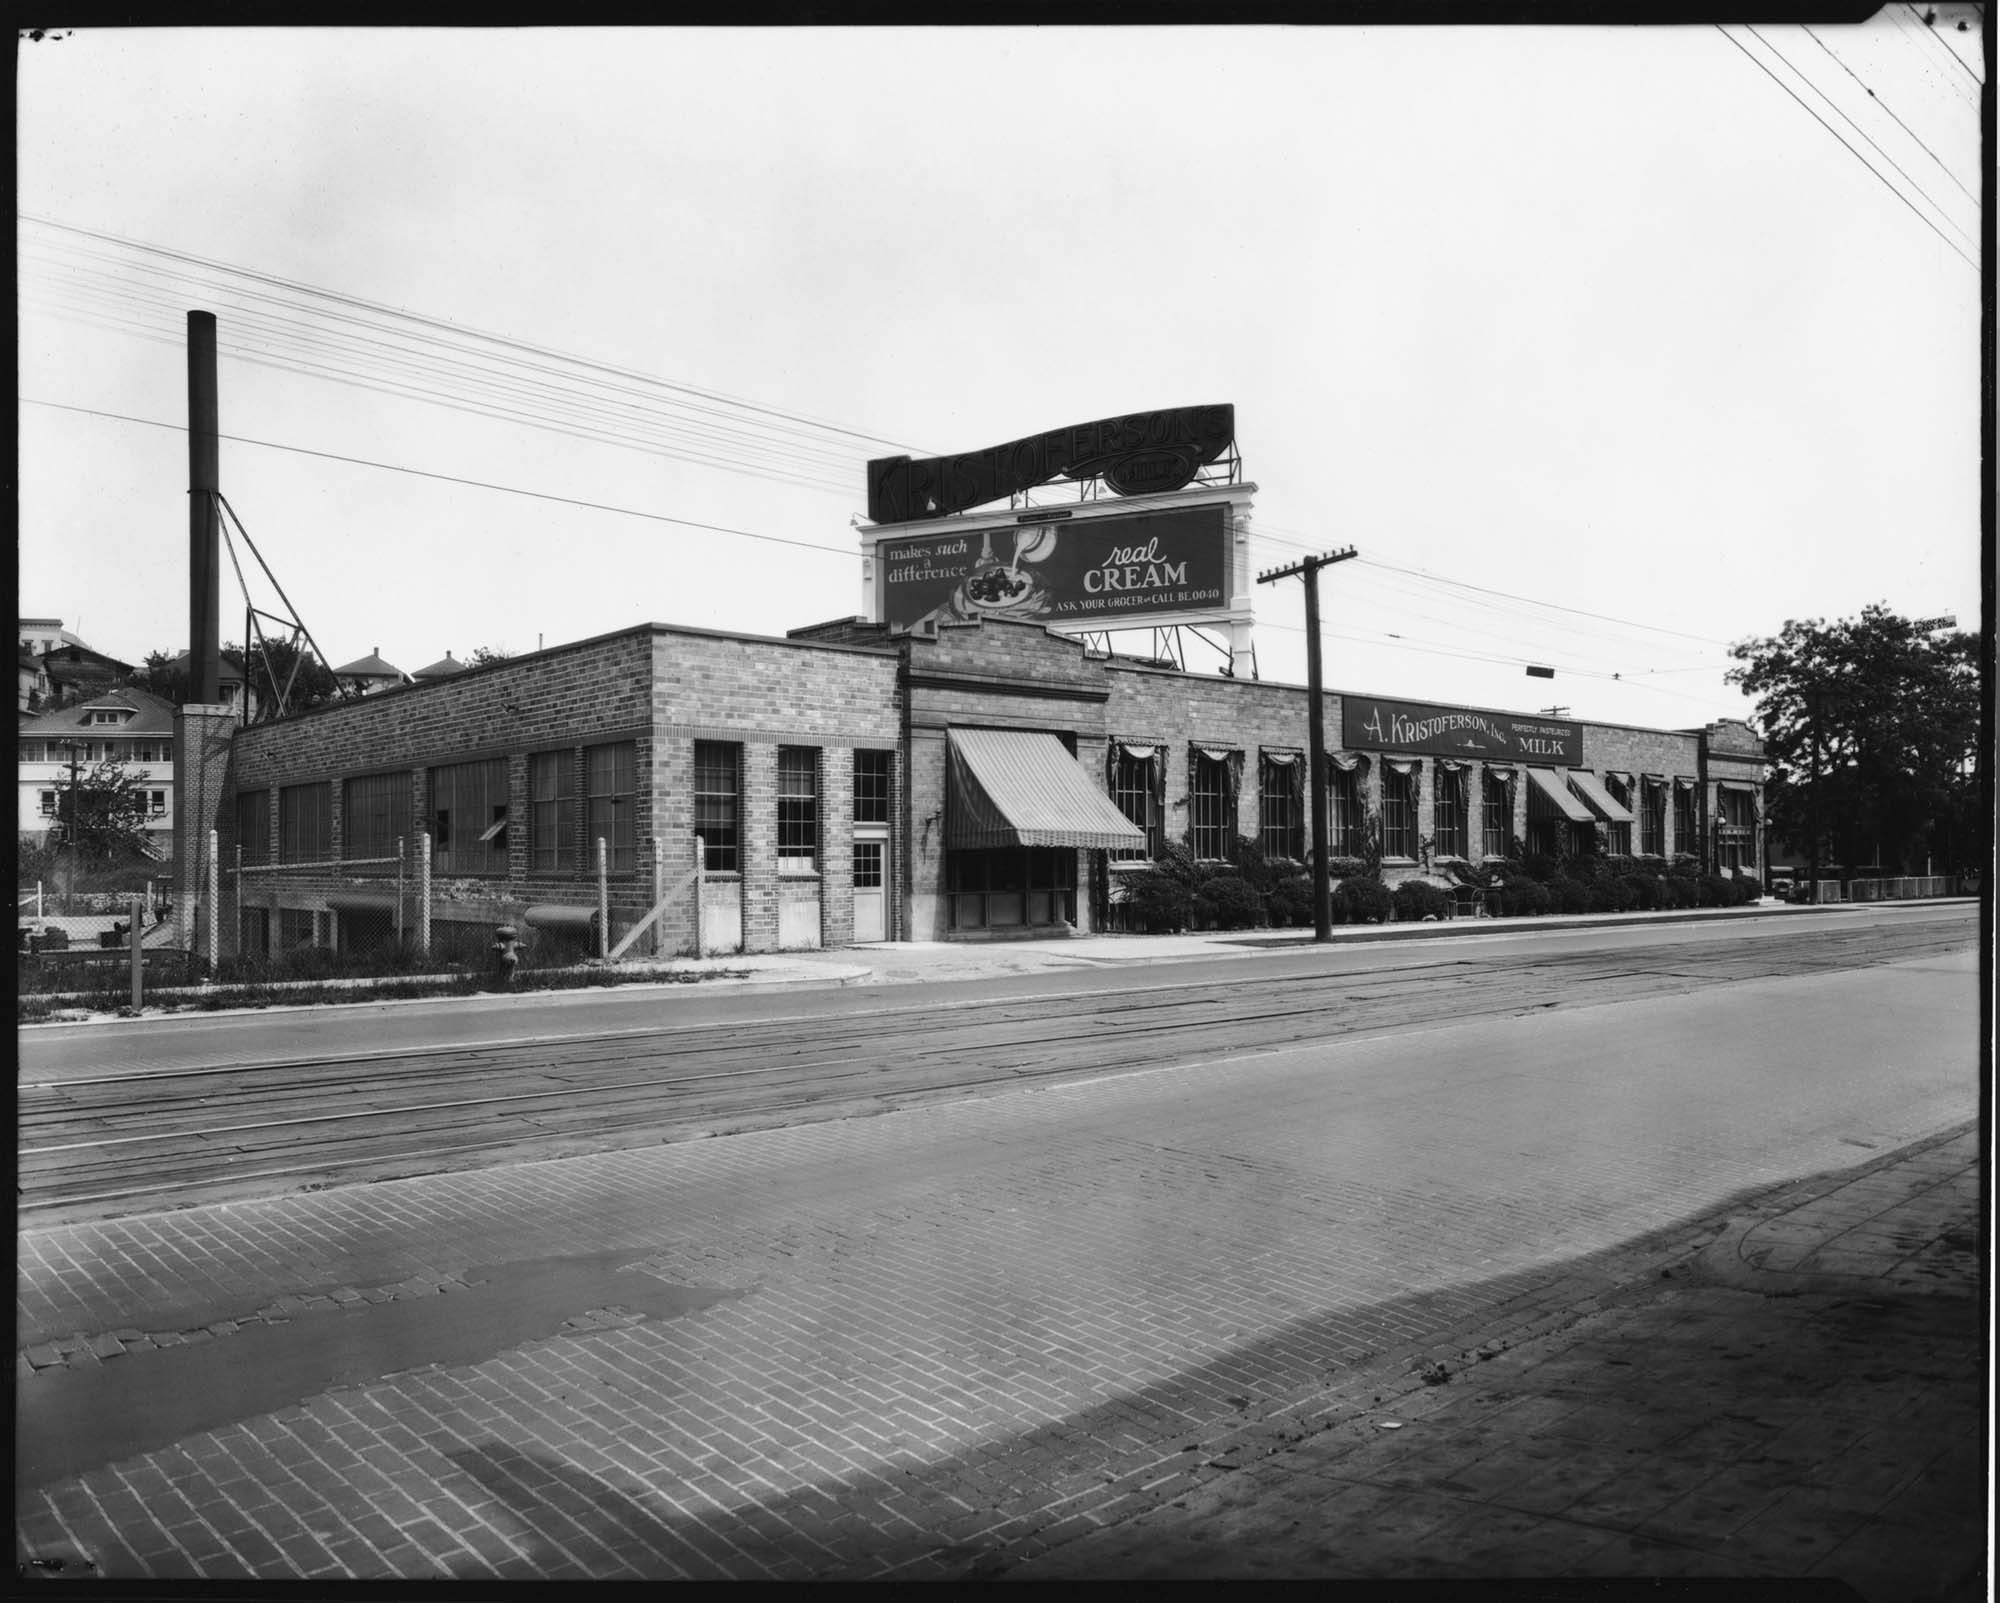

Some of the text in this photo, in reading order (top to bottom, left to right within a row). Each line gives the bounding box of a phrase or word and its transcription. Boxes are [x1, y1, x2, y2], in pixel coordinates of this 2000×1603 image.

[890, 539, 967, 561] makes such
[1102, 536, 1167, 567] real
[888, 565, 967, 583] difference
[923, 559, 931, 569] a
[1083, 561, 1187, 593] CREAM
[1056, 601, 1077, 612] ASK
[1080, 599, 1105, 610] YOUR
[1107, 595, 1143, 608] GROCER
[1151, 592, 1175, 605] CALL
[1363, 706, 1389, 743] A.
[1519, 737, 1565, 756] MILK
